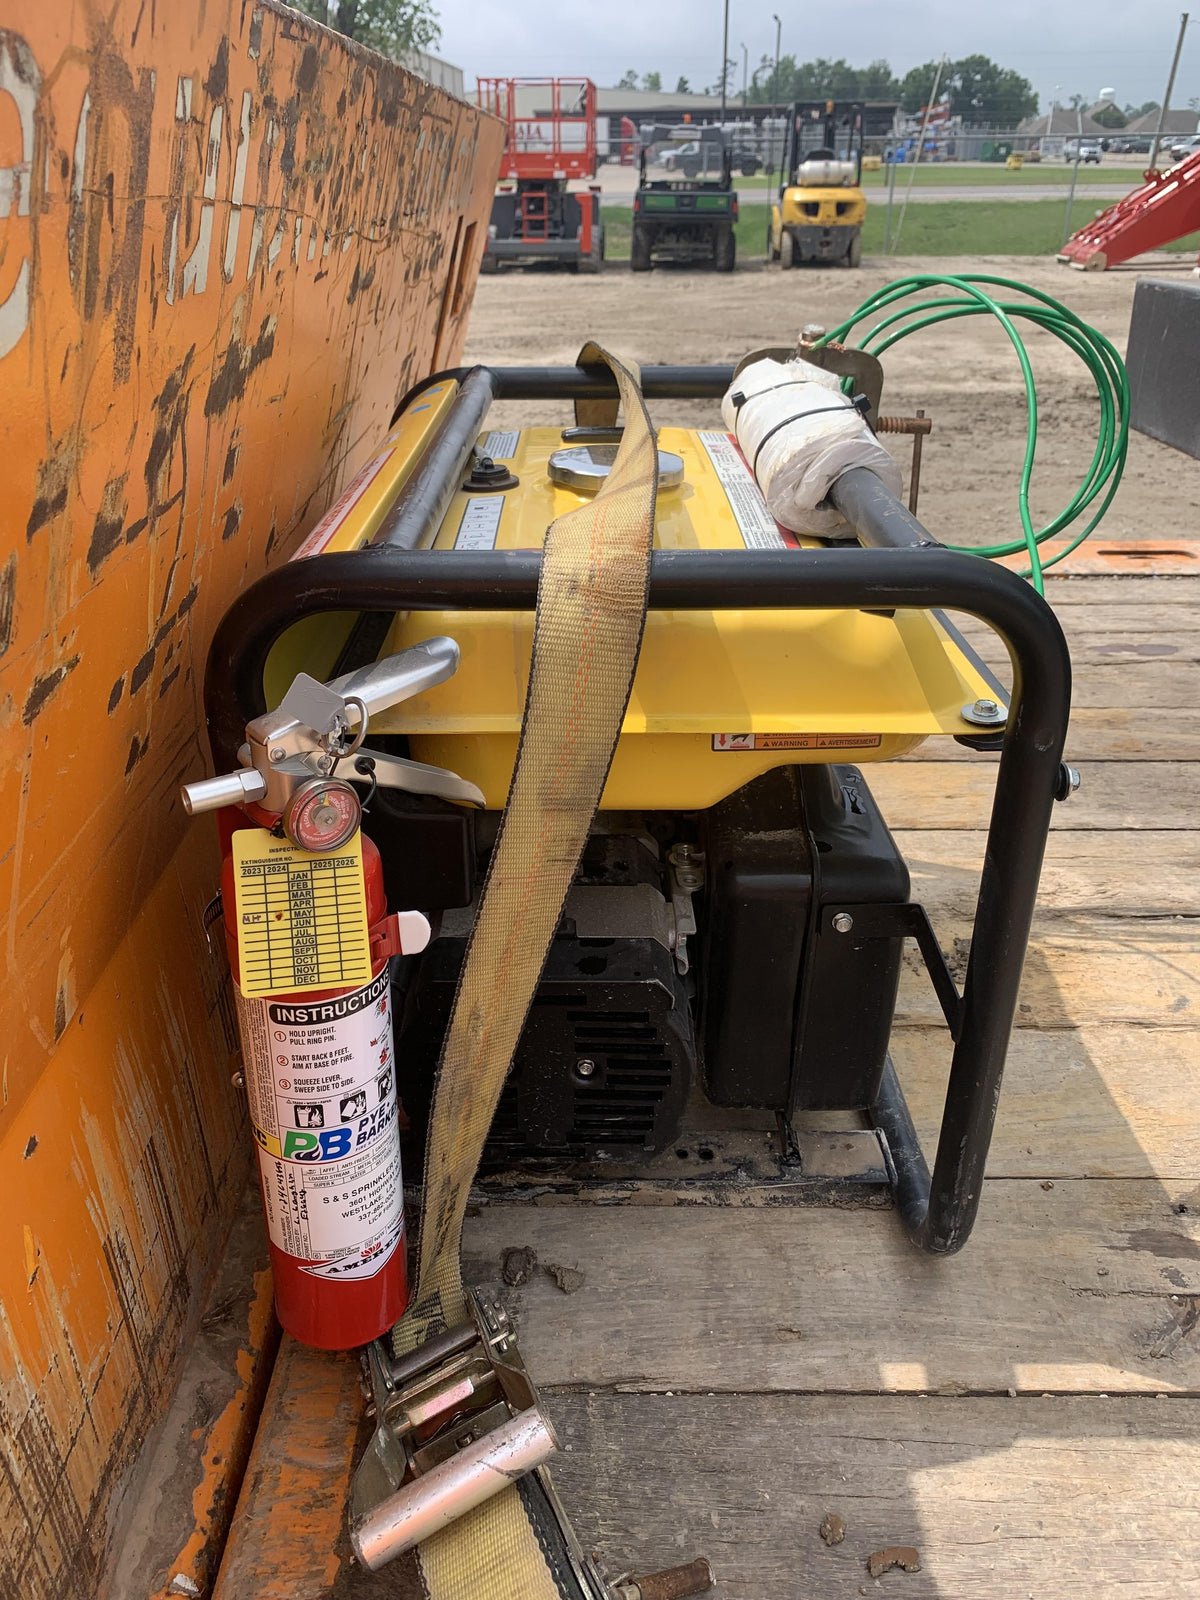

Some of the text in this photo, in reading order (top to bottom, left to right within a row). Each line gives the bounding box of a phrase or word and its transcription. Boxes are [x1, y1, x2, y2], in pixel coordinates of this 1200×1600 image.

[241, 857, 283, 865] EXTINGUISHER
[291, 873, 308, 881] JAN
[292, 891, 311, 899] MAR
[293, 900, 312, 908] APR
[294, 909, 312, 918] MAY
[294, 919, 311, 927] JUN
[295, 929, 311, 937] JUL
[295, 947, 316, 955] SEPT
[296, 957, 315, 965] OCT
[297, 966, 315, 974] NOV
[297, 975, 315, 984] DEC
[289, 1029, 306, 1037] HOLD
[307, 1027, 336, 1037] UPRIGHT.
[307, 1036, 322, 1044] RING
[335, 1047, 349, 1056] FEET.
[331, 1058, 338, 1066] OF
[340, 1055, 354, 1064] FIRE.
[294, 1076, 320, 1085] SQUEEZE
[322, 1074, 342, 1084] LEVER.
[294, 1085, 314, 1093] SWEEP
[317, 1084, 330, 1092] SIDE
[341, 1077, 356, 1087] SIDE.
[330, 1171, 350, 1180] STREAM
[350, 1170, 366, 1179] WATER
[352, 1163, 394, 1197] SPRINKLER
[349, 1196, 366, 1207] 3601
[325, 1226, 402, 1273] AMEREX
